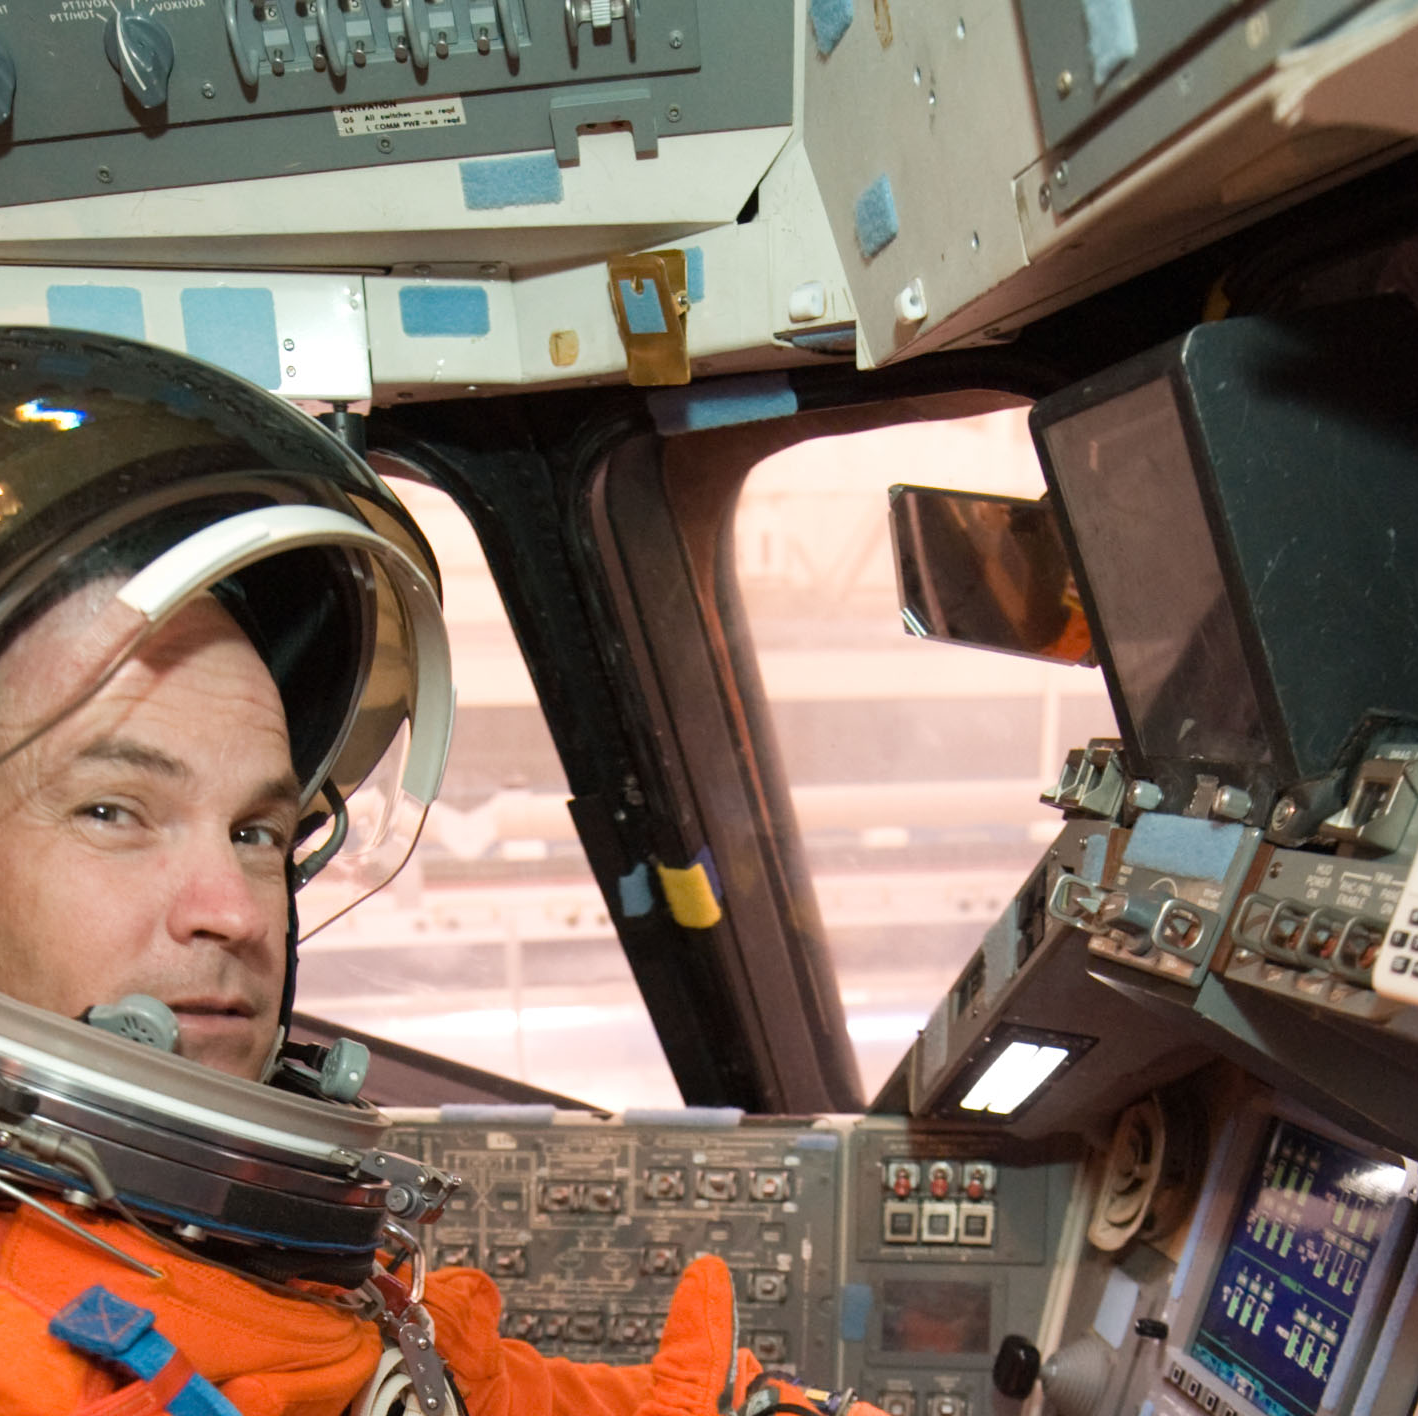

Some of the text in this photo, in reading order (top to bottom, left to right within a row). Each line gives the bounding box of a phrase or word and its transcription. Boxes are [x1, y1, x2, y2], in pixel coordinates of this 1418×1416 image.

[49, 10, 95, 23] PTT/HOT
[340, 100, 397, 114] ACTIVATION
[374, 121, 400, 131] COMM
